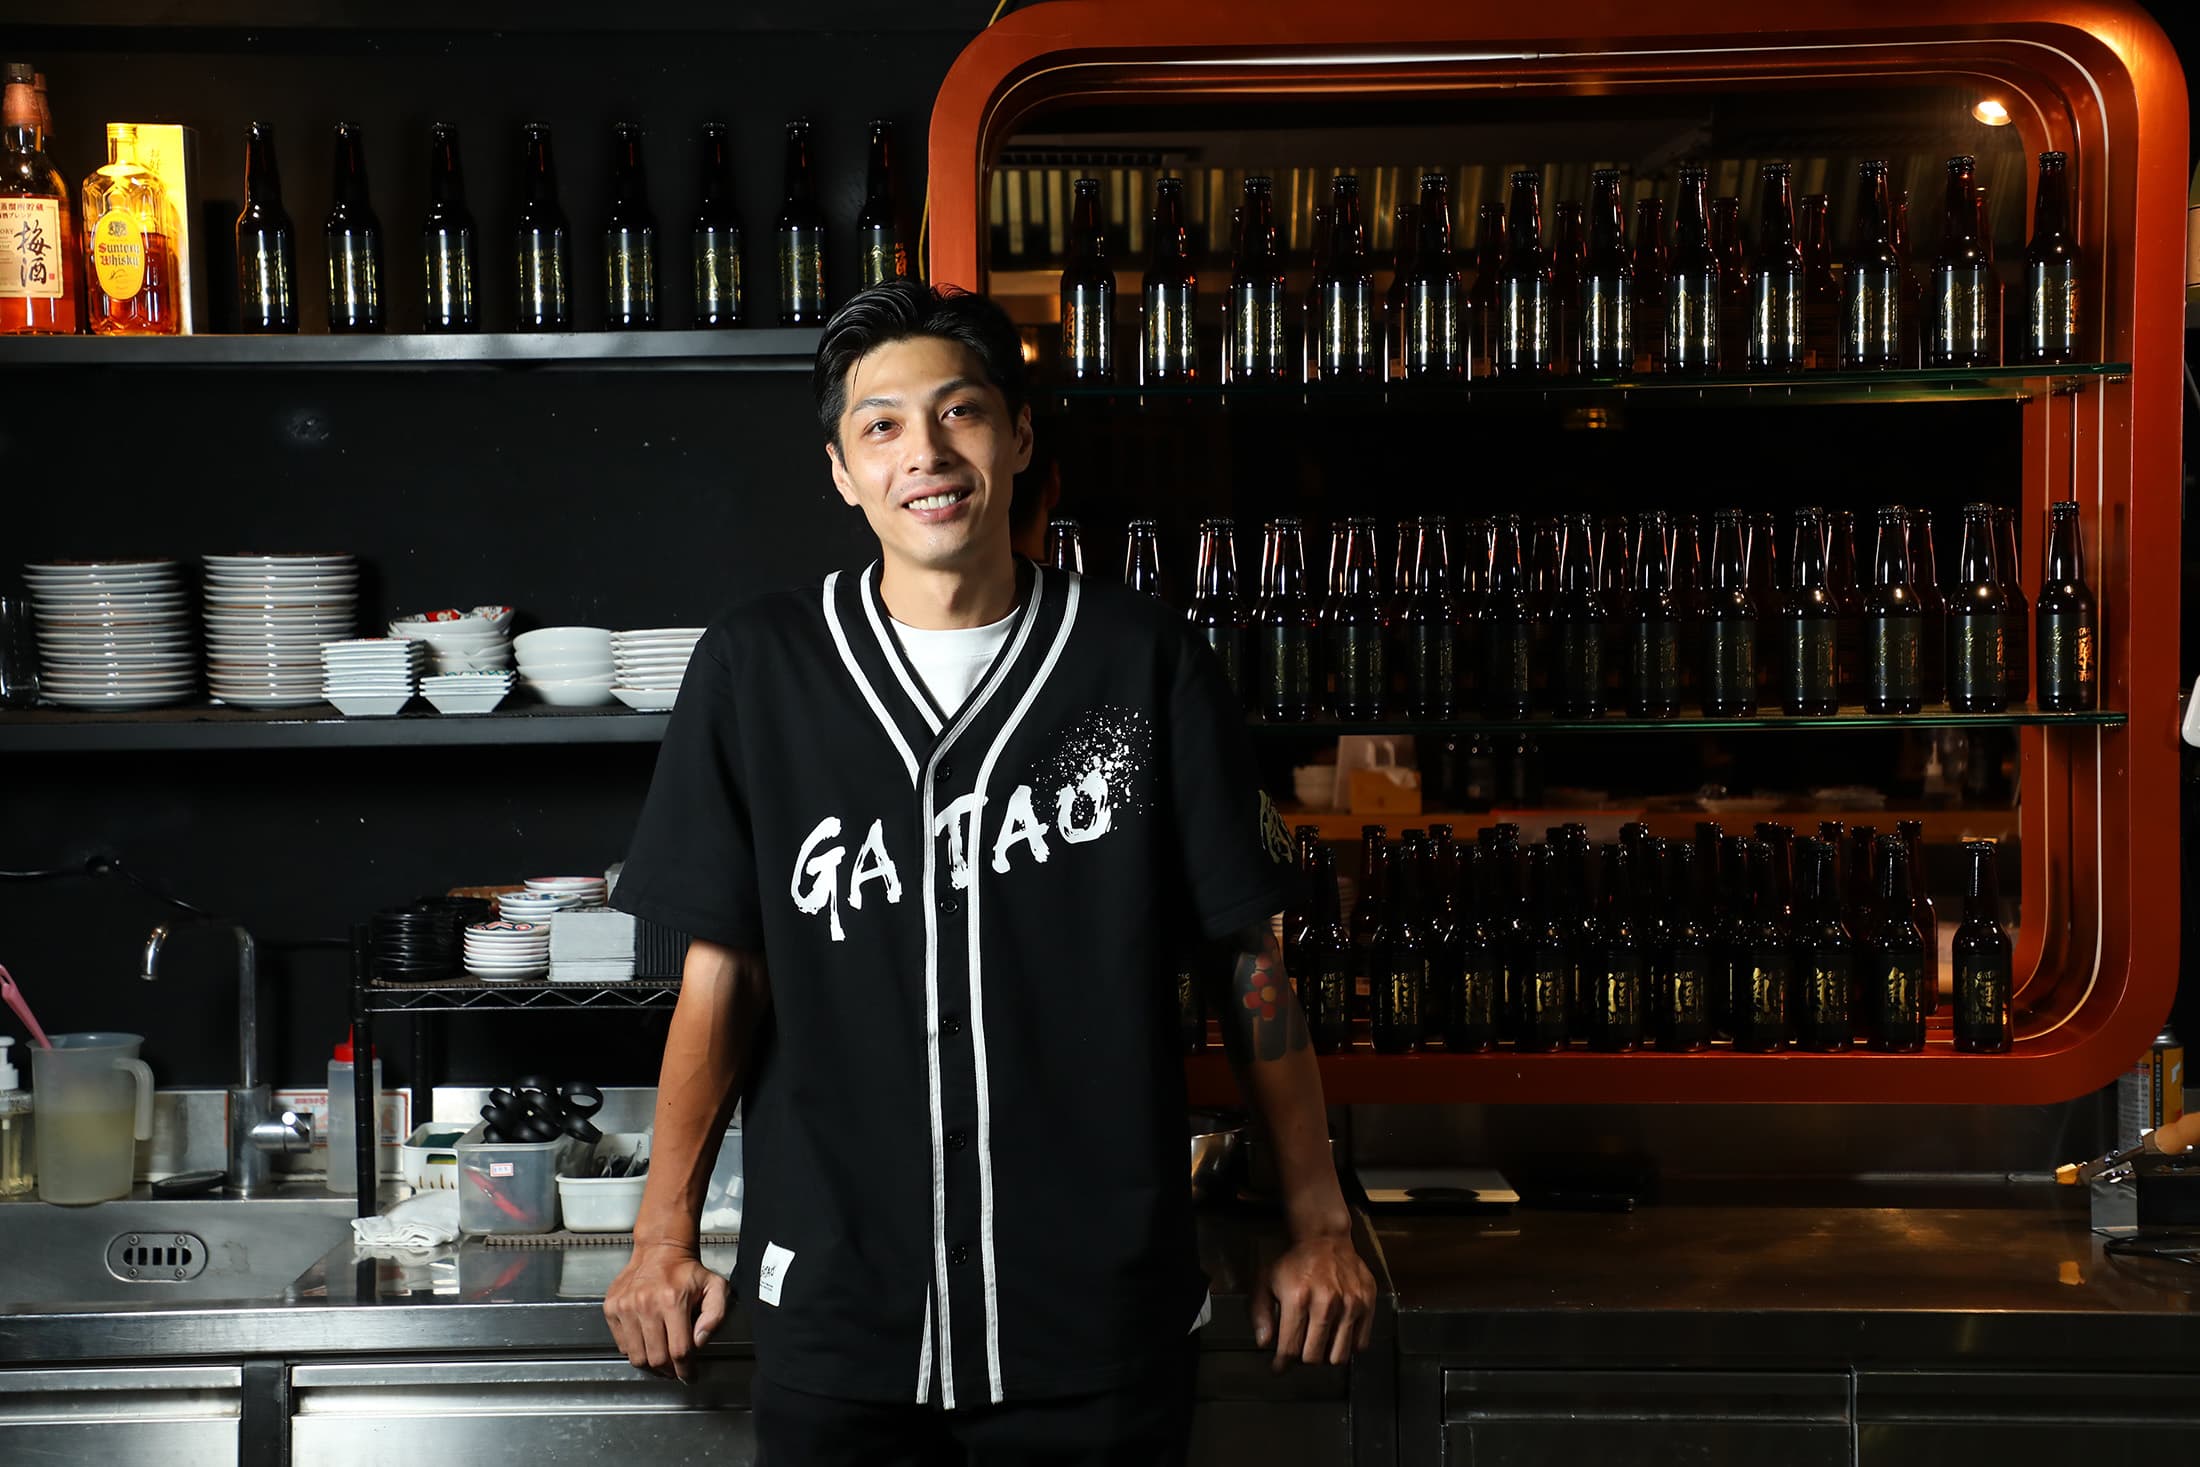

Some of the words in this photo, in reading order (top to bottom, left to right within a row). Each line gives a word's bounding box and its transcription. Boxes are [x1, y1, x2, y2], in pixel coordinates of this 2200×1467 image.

[13, 219, 52, 288] 梅酒
[98, 242, 140, 254] Suntory
[99, 254, 139, 267] Whisky
[790, 768, 1114, 942] GATAO
